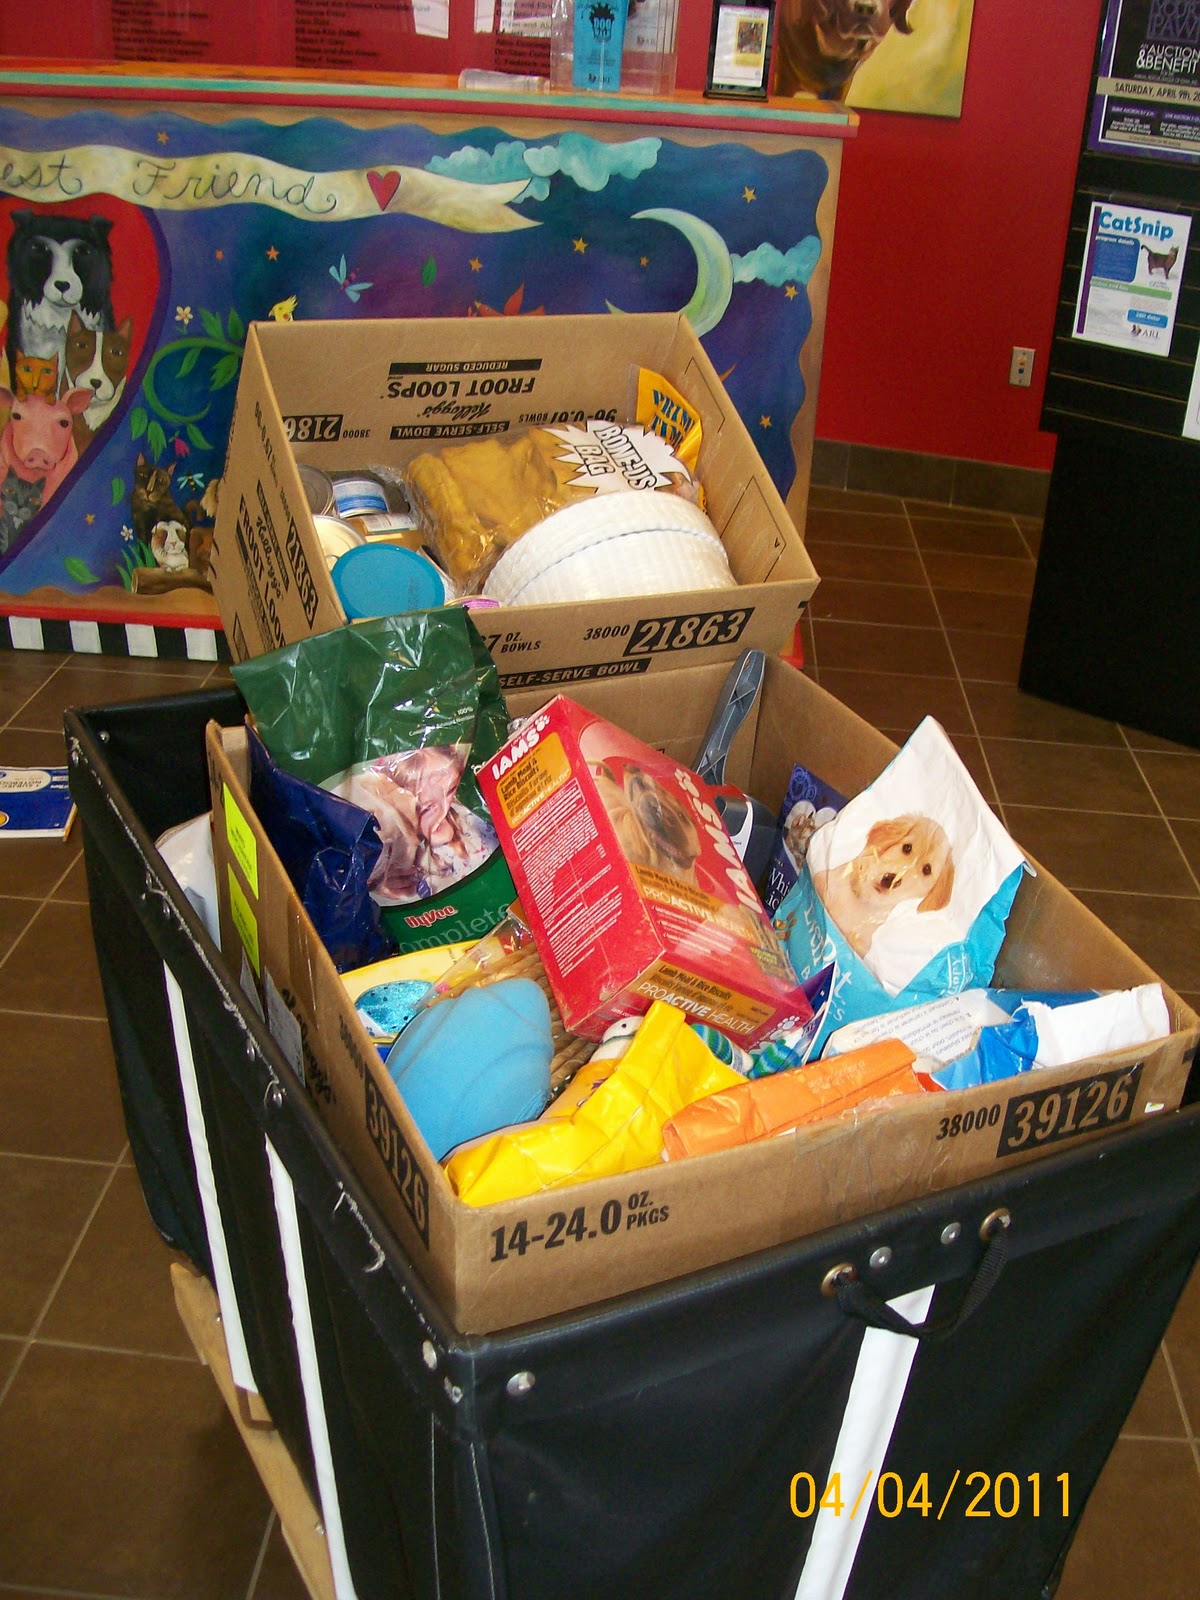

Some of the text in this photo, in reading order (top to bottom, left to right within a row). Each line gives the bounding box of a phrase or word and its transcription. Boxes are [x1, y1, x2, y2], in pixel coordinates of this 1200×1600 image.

[1150, 44, 1200, 60] AUCTION
[1115, 83, 1154, 97] SATURDAY,
[1156, 87, 1176, 98] APRIL
[133, 159, 337, 214] Friend
[1100, 211, 1174, 241] CatSnip
[425, 360, 509, 372] REDUCED SUGAR
[387, 377, 536, 398] FROOT LOOPS
[283, 415, 340, 442] 2186
[395, 422, 506, 437] SELF-SERVE BOWL
[572, 444, 609, 477] BAG
[240, 492, 265, 582] FROOT
[501, 640, 542, 654] BOWLS
[583, 624, 630, 641] 38000
[629, 610, 746, 654] 21863
[596, 662, 642, 676] BOWL
[490, 729, 541, 780] IAMS
[499, 773, 519, 794] Lamb
[516, 762, 532, 779] Meal
[502, 765, 540, 802] Rice Biscuits
[699, 804, 762, 914] IAMS
[658, 964, 678, 978] Lamb
[675, 971, 694, 985] Meal
[695, 980, 711, 992] Rice
[708, 985, 733, 1001] Biscuits
[636, 981, 712, 1017] PROACTIVE
[706, 1010, 755, 1035] HEALTH
[936, 1104, 1002, 1142] 38000
[1006, 1074, 1135, 1150] 39126
[489, 1191, 652, 1264] 14-24.0 OZ.
[626, 1204, 670, 1231] PKGS
